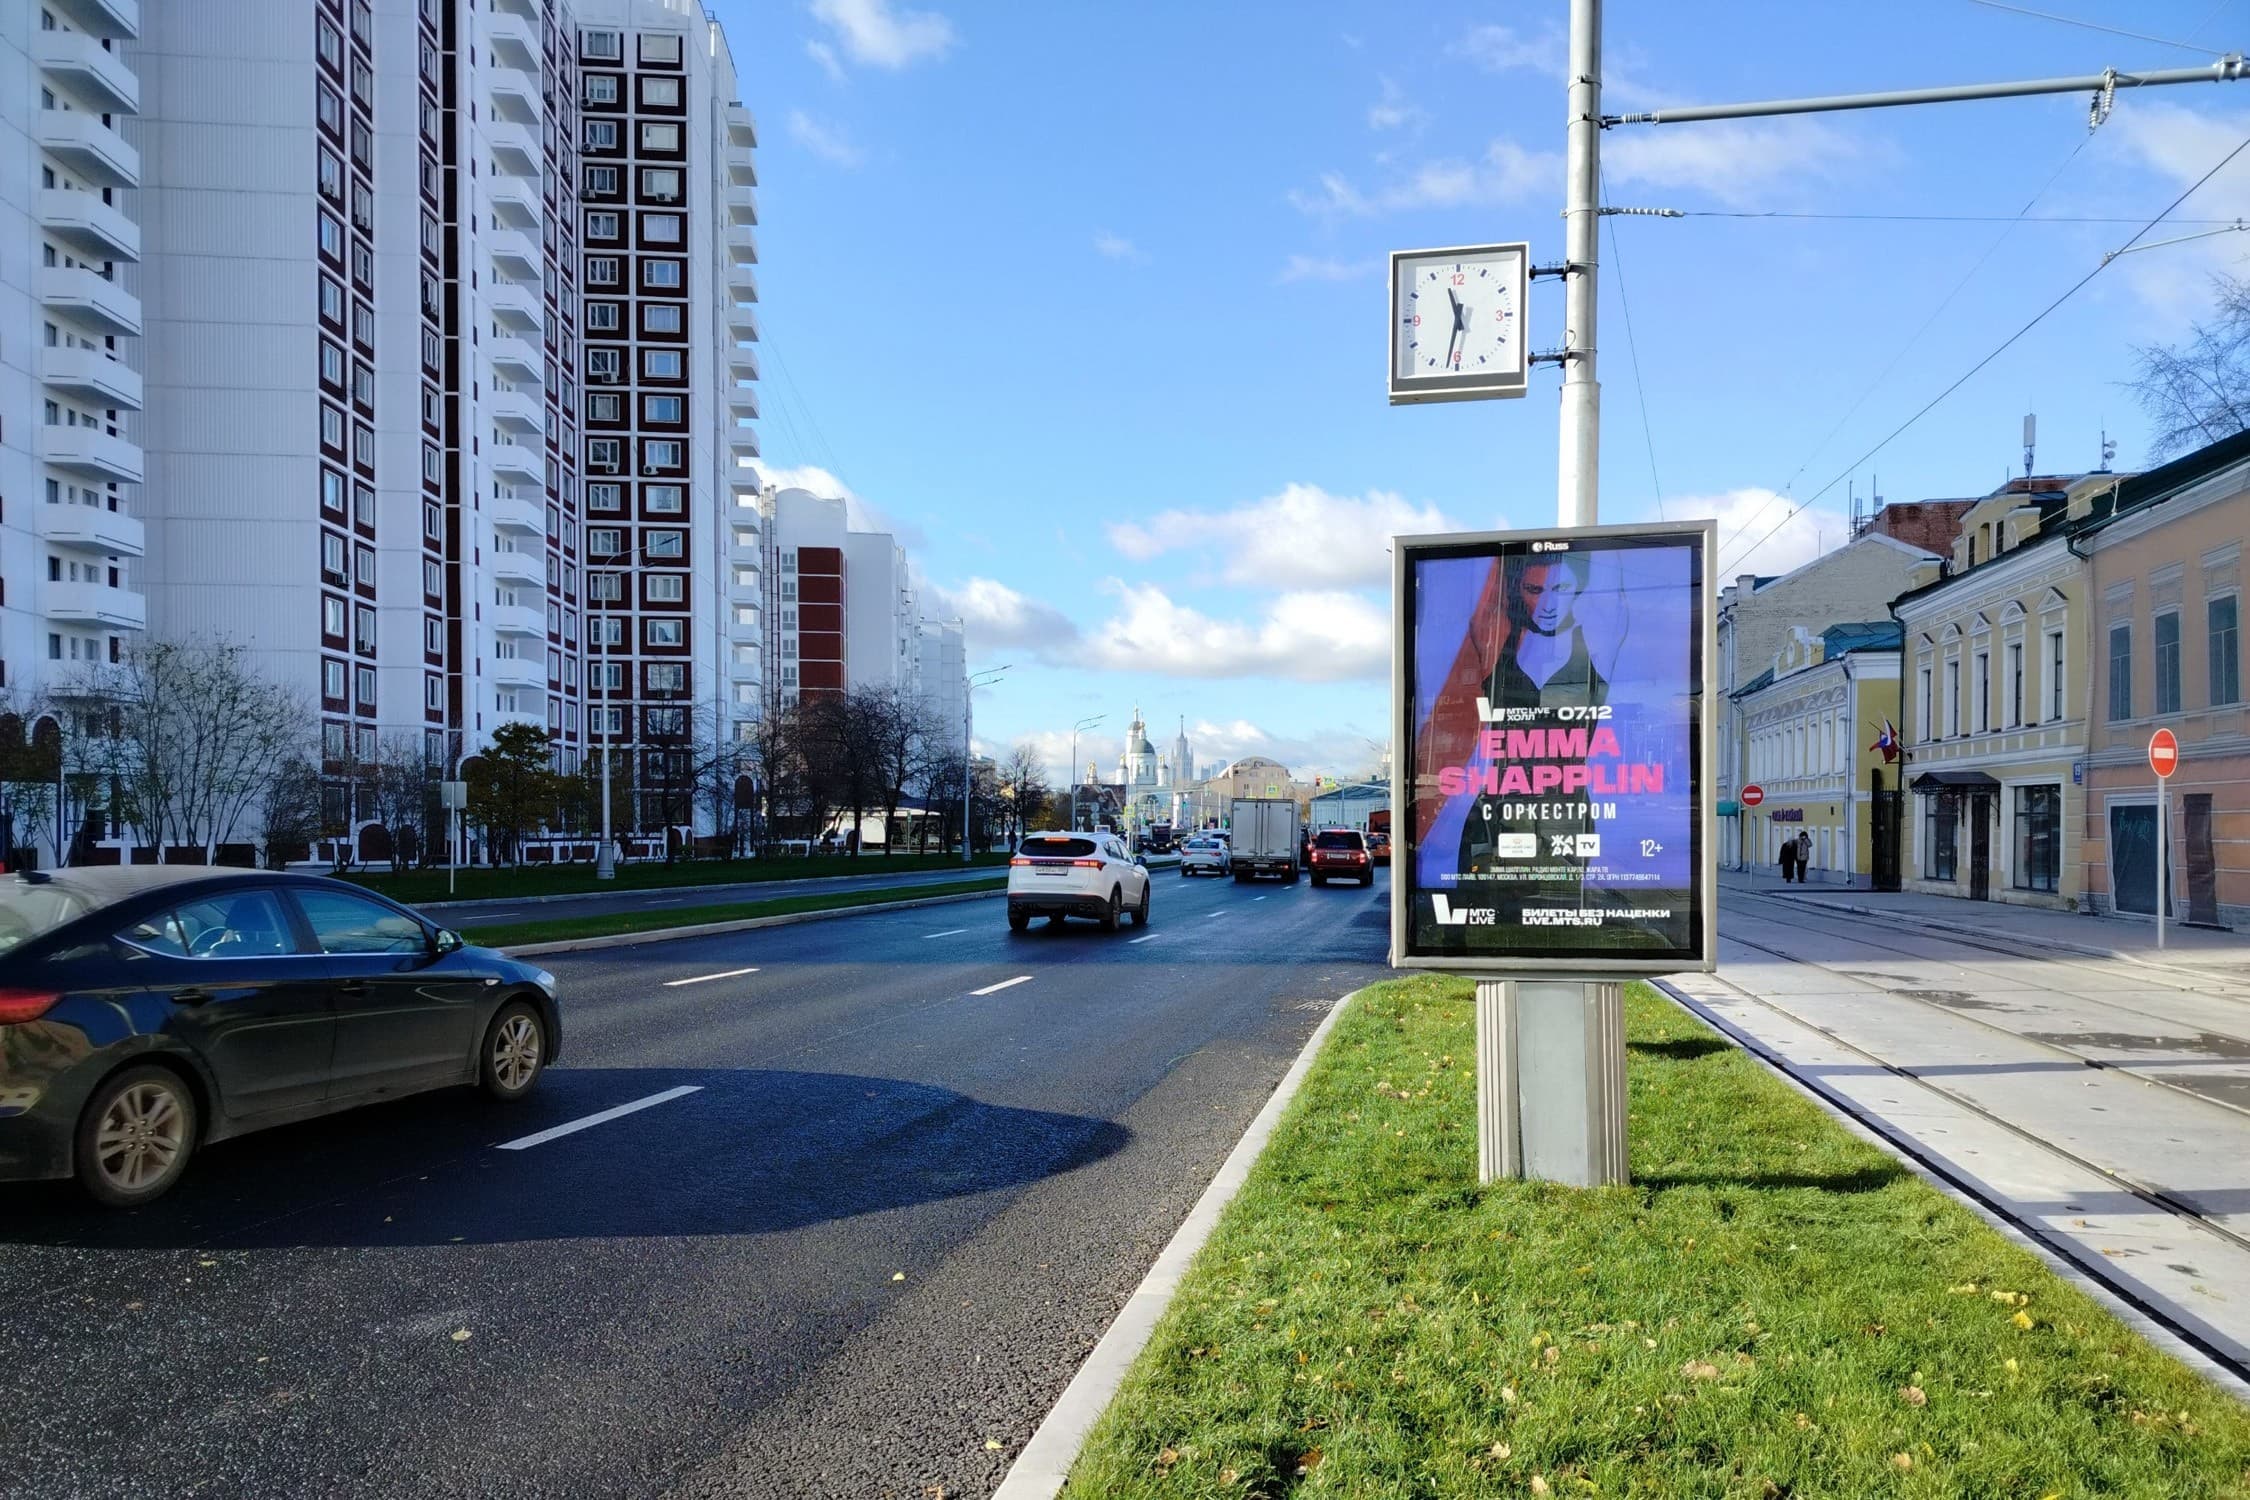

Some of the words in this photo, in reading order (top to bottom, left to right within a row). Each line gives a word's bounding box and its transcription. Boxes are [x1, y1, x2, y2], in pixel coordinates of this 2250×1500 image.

[1451, 274, 1465, 285] 12
[1413, 315, 1421, 327] 9
[1496, 309, 1504, 322] 3
[1453, 351, 1462, 362] 6
[1544, 541, 1569, 551] Russ
[1529, 706, 1550, 714] LIVE
[1557, 705, 1613, 721] 07.12
[1480, 727, 1621, 759] EMMA
[1438, 763, 1664, 796] SHAPPLIN
[1482, 803, 1493, 821] С
[1503, 802, 1617, 821] ОРКЕСТРОМ
[1580, 841, 1596, 849] TV
[1640, 839, 1663, 857] 12+
[1522, 908, 1578, 918] БИЛЕТЫ
[1579, 908, 1604, 918] БЕЗ
[1606, 908, 1671, 919] НАЦЕНКИ
[1469, 916, 1496, 925] LIVE
[1522, 916, 1603, 926] LIVE.MTS.RU
